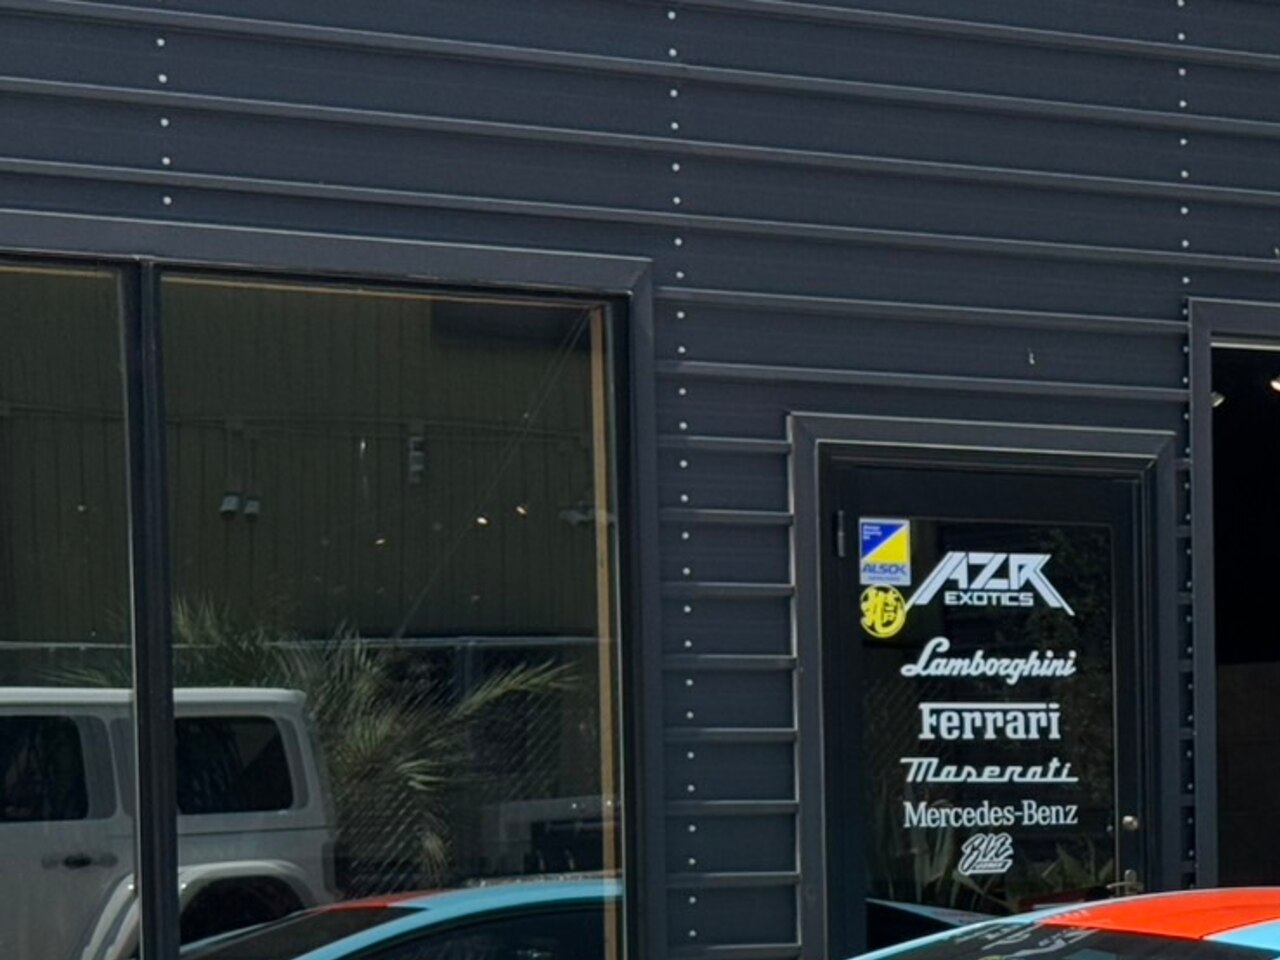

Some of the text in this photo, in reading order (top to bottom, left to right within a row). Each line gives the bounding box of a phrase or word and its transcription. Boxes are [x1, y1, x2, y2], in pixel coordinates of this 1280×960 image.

[944, 590, 1035, 607] EXOTICS
[901, 637, 1077, 685] Lamborghini
[918, 702, 1061, 740] Ferrari
[900, 757, 1079, 783] Maserati
[903, 800, 1078, 829] Mercedes-Benz
